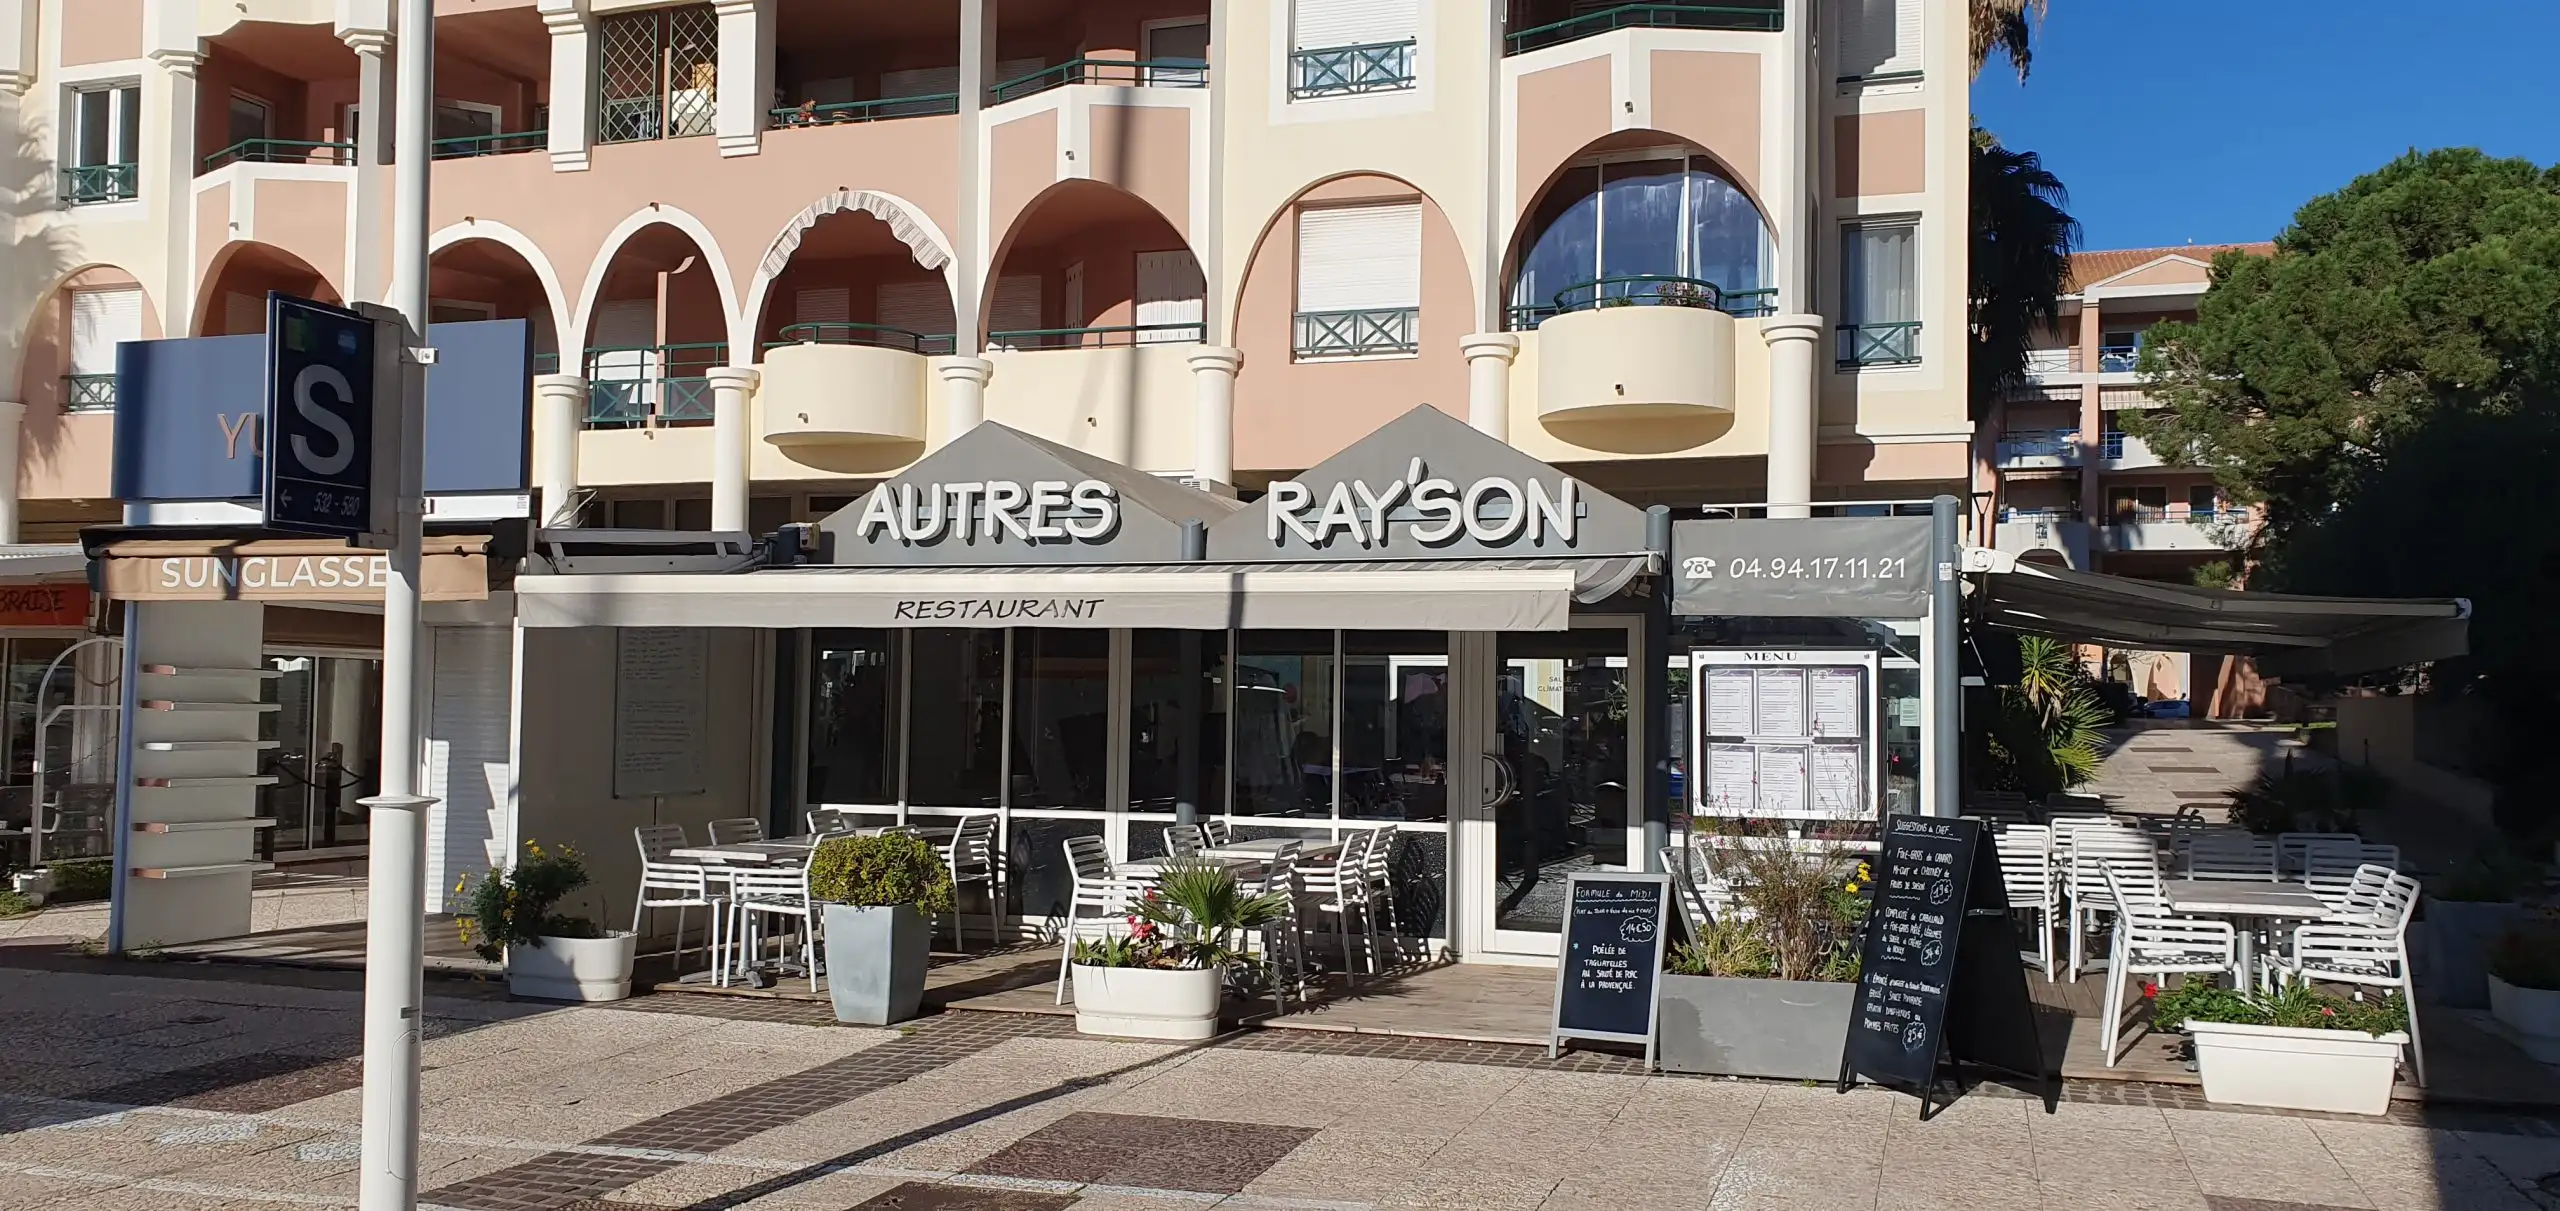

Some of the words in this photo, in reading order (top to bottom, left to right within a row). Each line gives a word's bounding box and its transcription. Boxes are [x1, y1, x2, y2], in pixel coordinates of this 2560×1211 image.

[289, 364, 355, 475] S
[857, 480, 1116, 541] AUTRES
[1267, 457, 1575, 544] RAY'SON
[1729, 556, 1907, 580] 04.94.17.11.21
[894, 598, 1104, 620] RESTAURANT
[1743, 651, 1799, 662] MENU
[1549, 675, 1573, 683] SALE
[1576, 887, 1611, 898] FORMULE
[1617, 947, 1627, 955] DE
